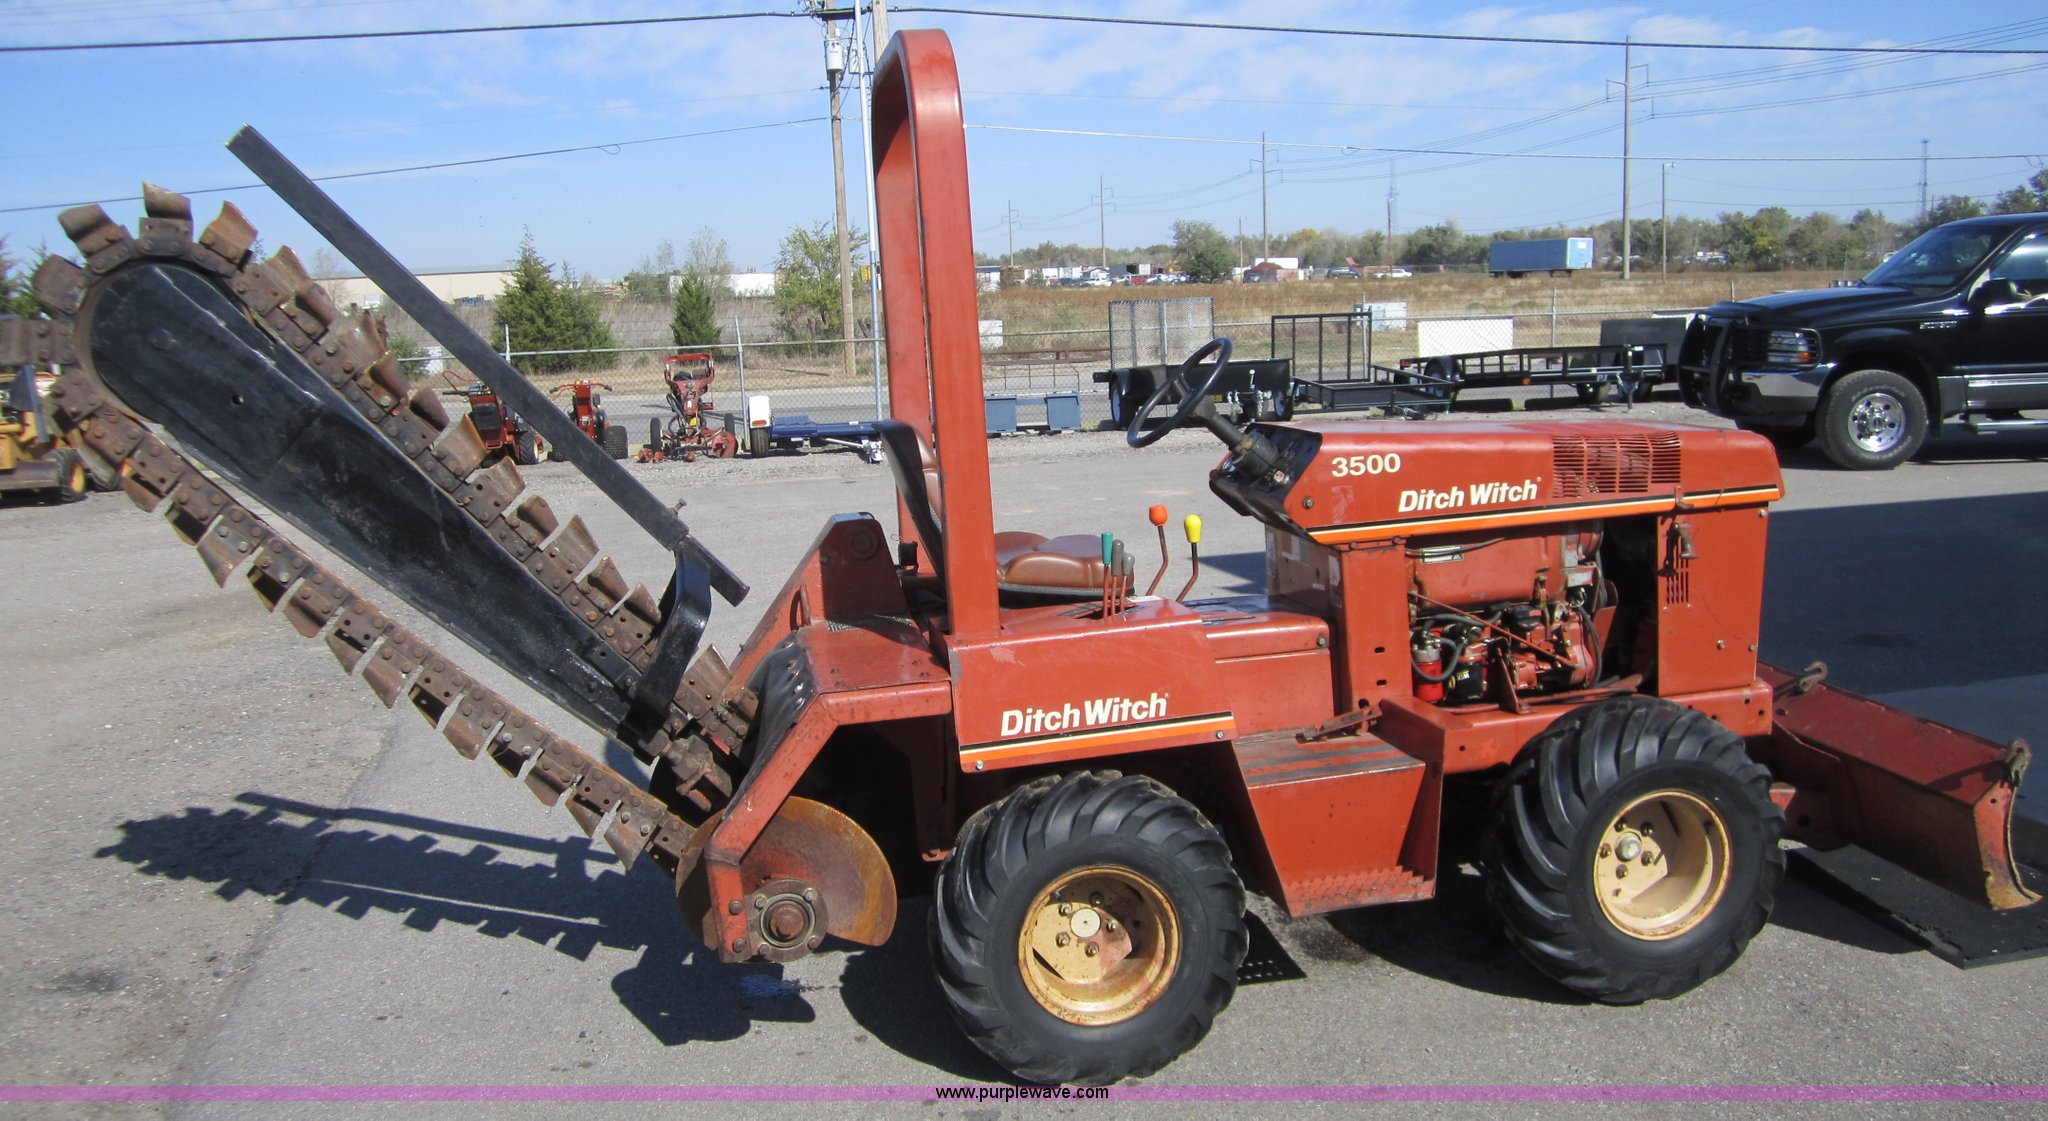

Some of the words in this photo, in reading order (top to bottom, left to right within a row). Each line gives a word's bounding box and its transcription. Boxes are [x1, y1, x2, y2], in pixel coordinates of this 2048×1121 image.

[1331, 453, 1401, 478] 3500
[1398, 486, 1464, 513] Ditch
[1469, 479, 1538, 506] Witch
[1000, 703, 1080, 737] Ditch
[1084, 692, 1167, 726] Witch
